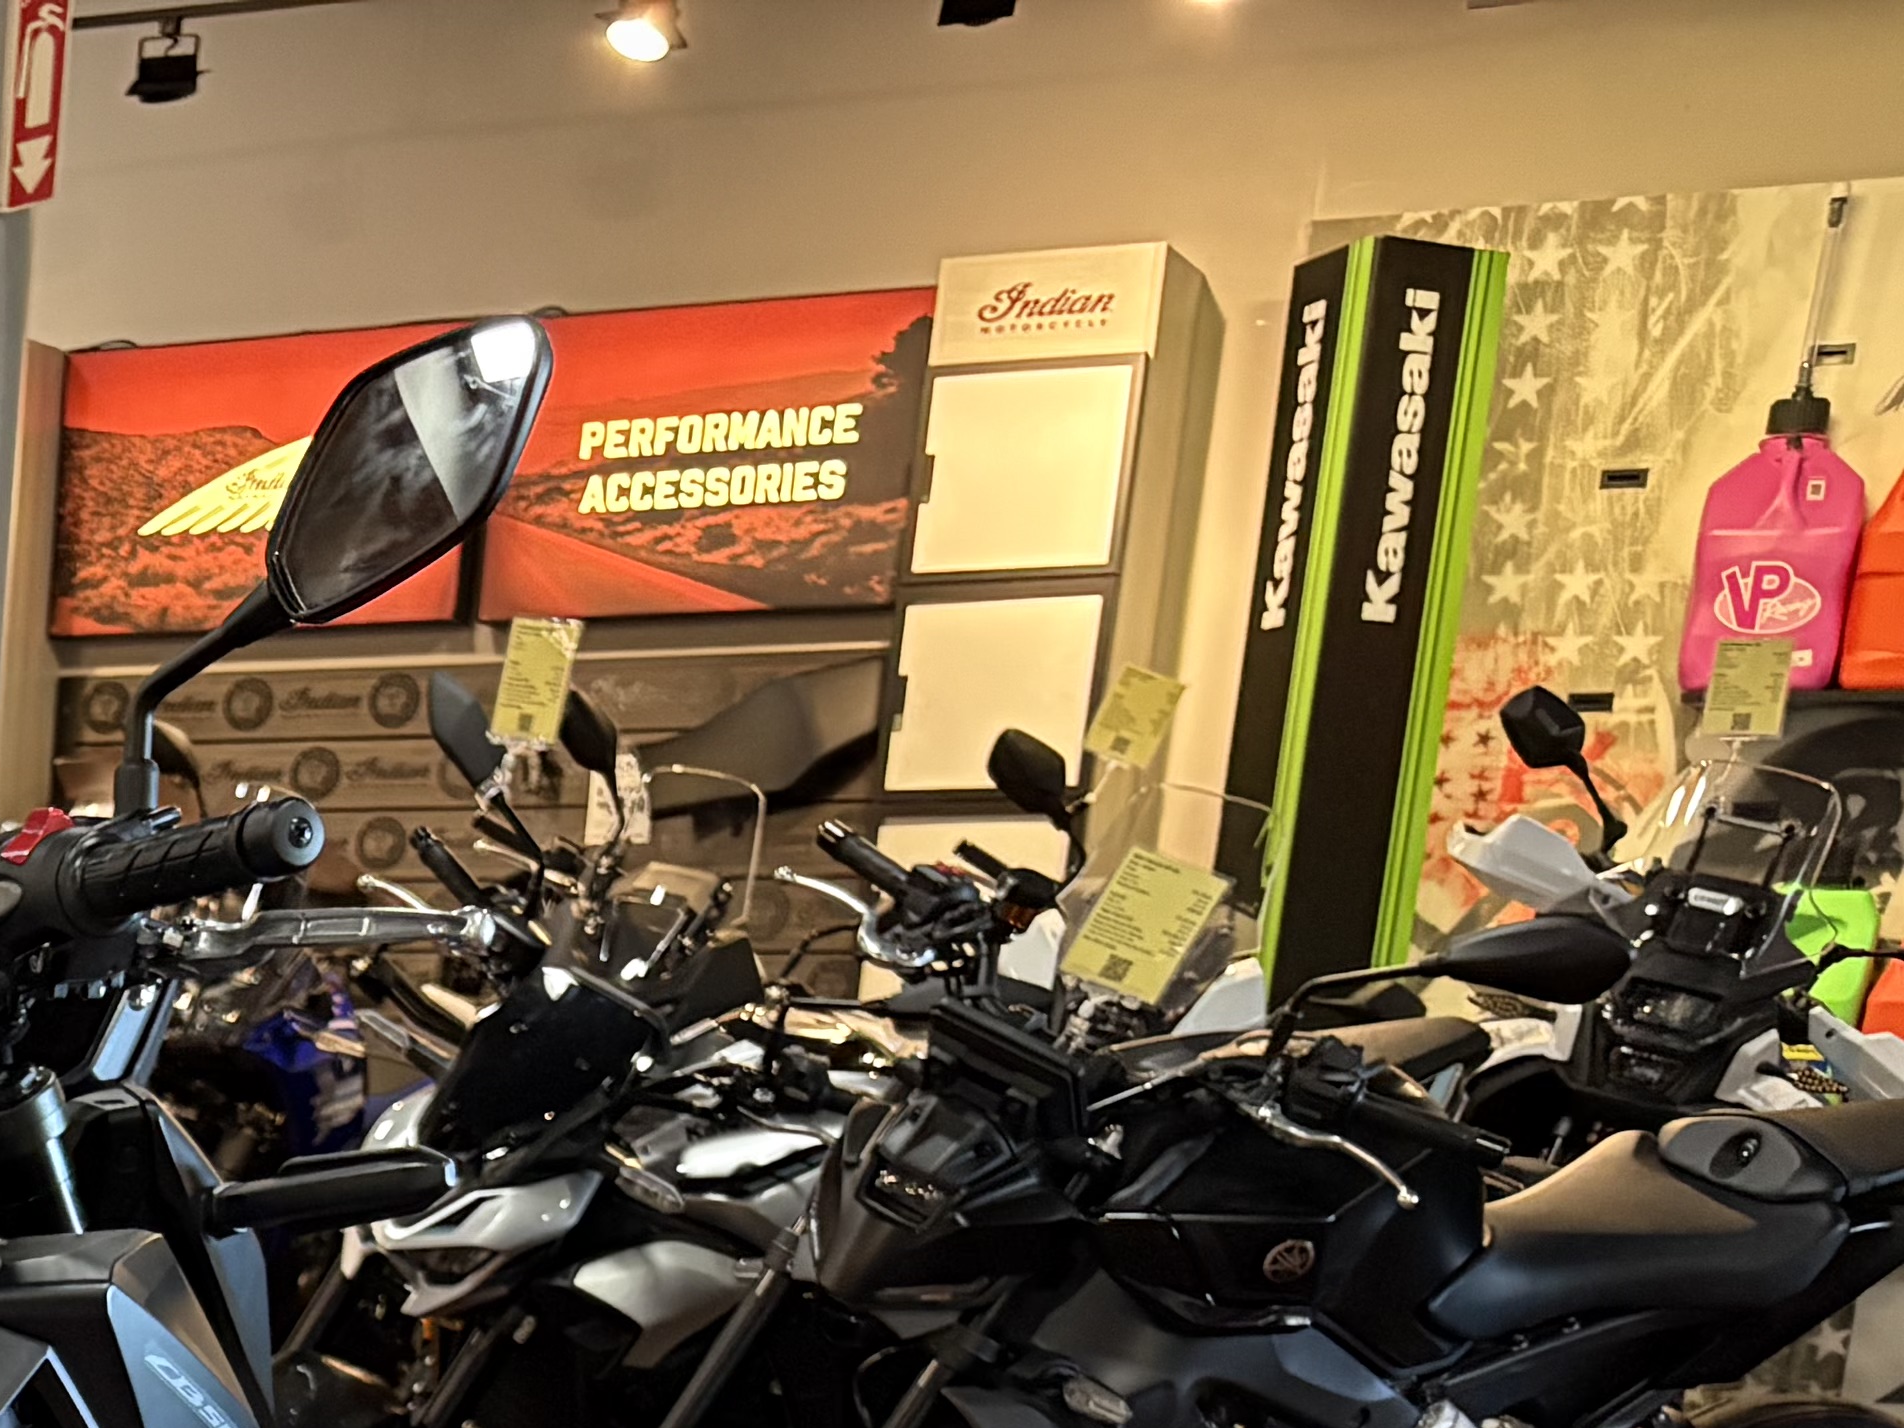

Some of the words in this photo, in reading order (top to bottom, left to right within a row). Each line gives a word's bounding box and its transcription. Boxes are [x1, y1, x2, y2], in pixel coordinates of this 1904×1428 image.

[976, 281, 1116, 322] Indian
[578, 403, 863, 461] PERFORMANCE
[1360, 287, 1441, 624] Kawasaki
[578, 459, 847, 515] ACCESSORIES
[1260, 298, 1328, 632] Kawasaki
[1721, 561, 1794, 631] VP
